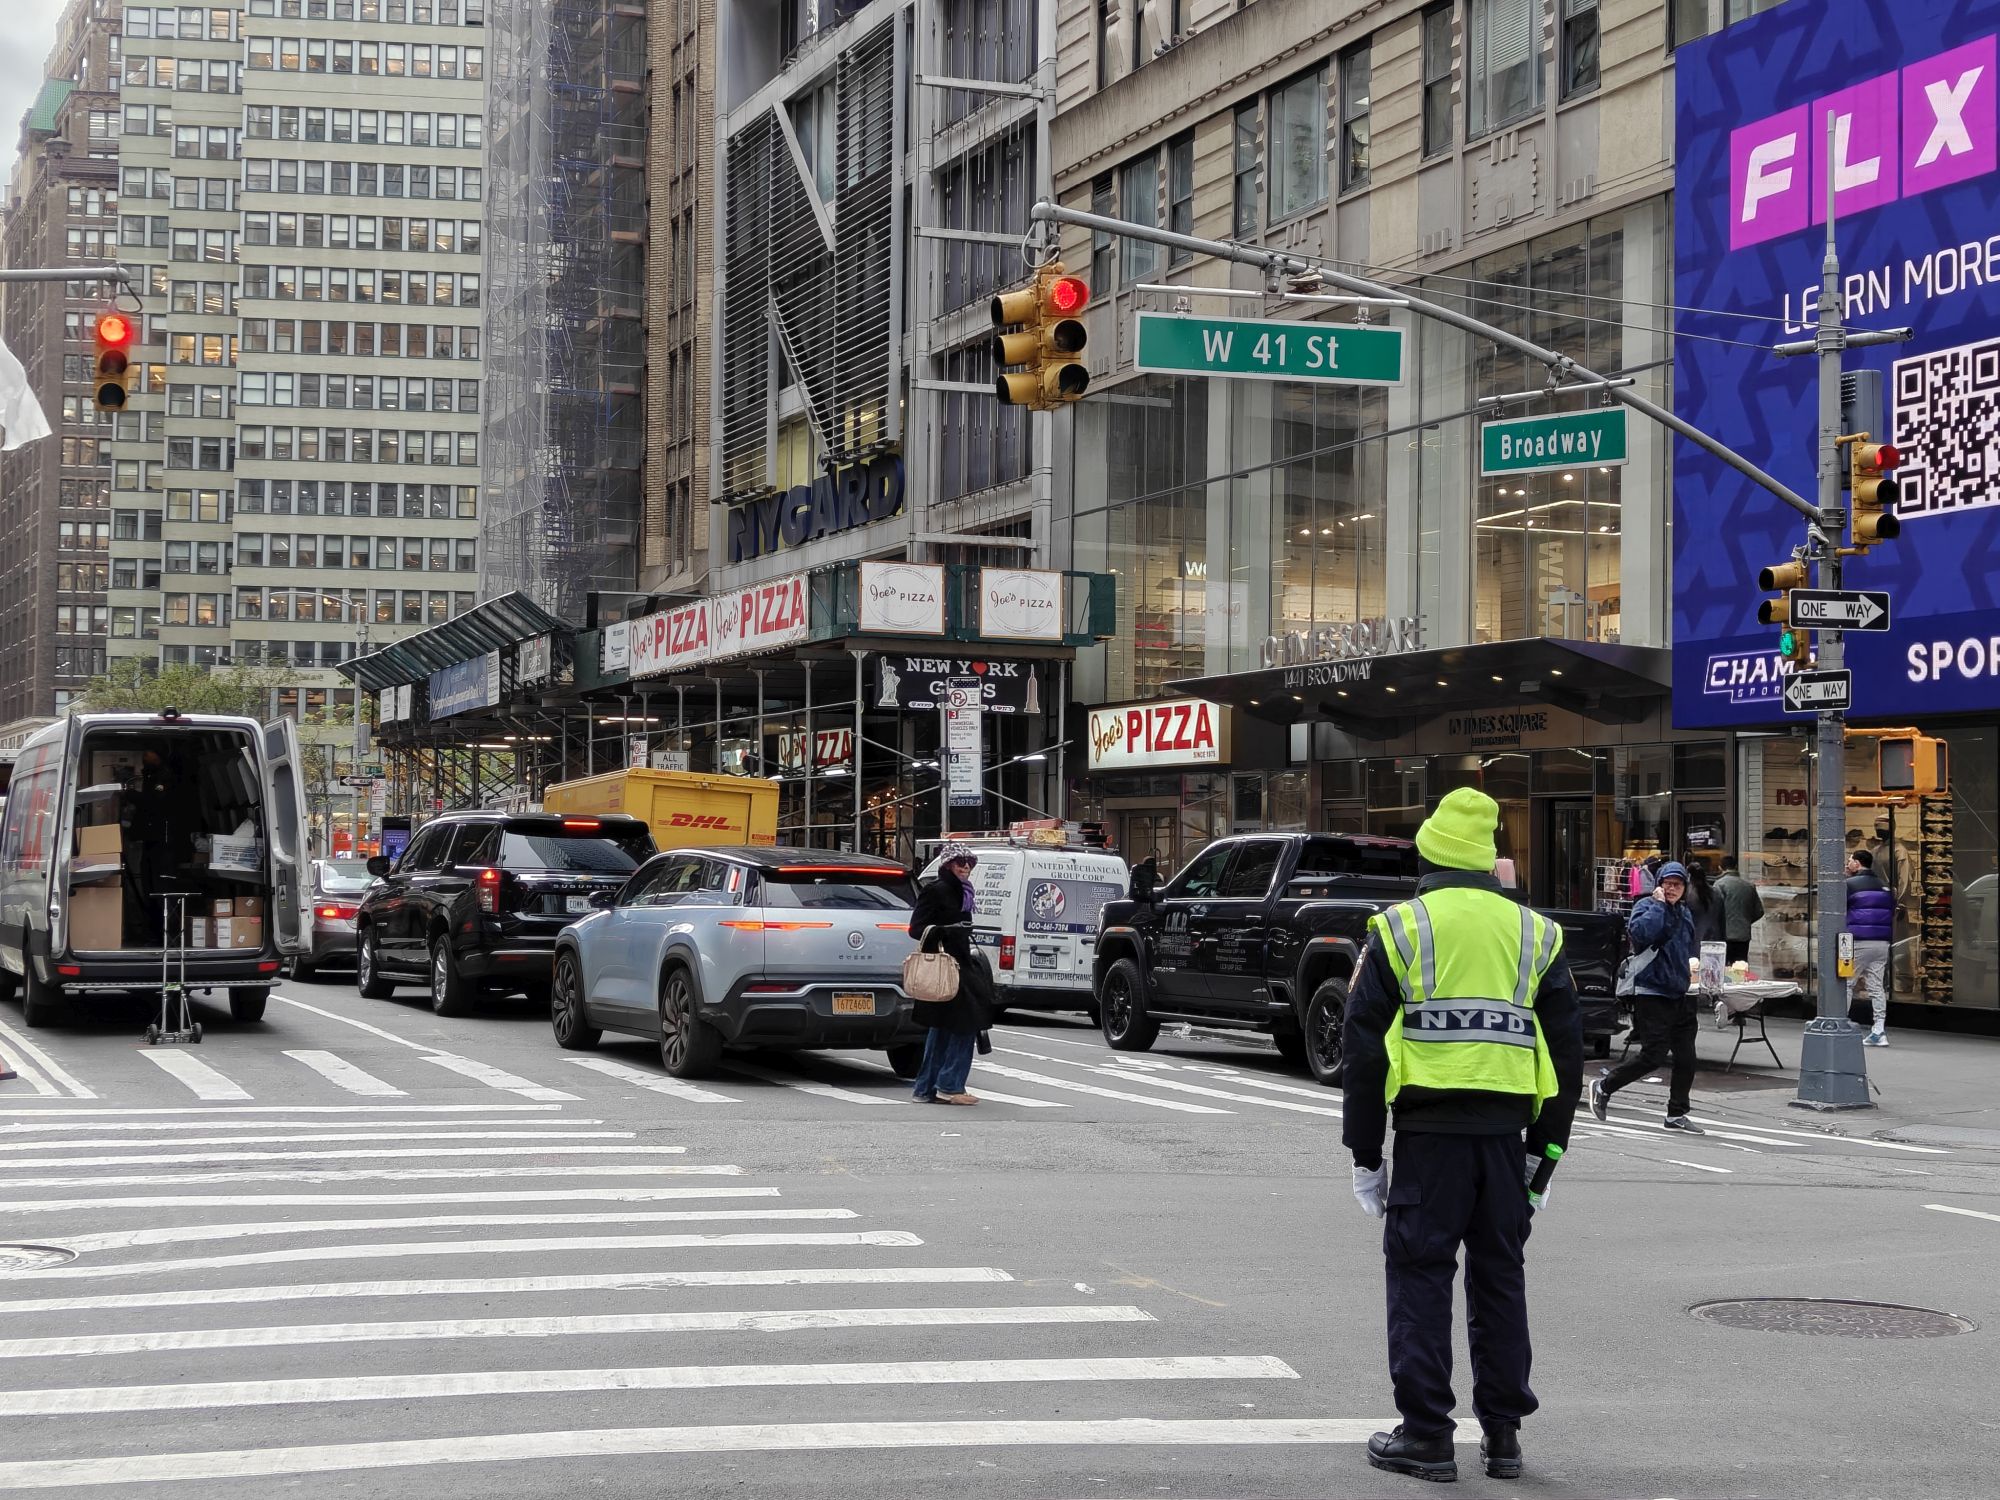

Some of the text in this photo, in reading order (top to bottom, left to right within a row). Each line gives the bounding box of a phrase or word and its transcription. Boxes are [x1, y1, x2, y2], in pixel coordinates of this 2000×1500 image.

[1741, 65, 1985, 224] FLX
[1783, 265, 1892, 335] LERN
[1202, 329, 1340, 369] W 41 St
[1501, 429, 1602, 461] Broadway
[869, 583, 935, 604] Joe's PIZZA
[990, 590, 1054, 609] Joe's PIZZA
[714, 578, 806, 651] Joe's PIZZA
[1801, 602, 1873, 619] ONE WAY
[632, 624, 653, 671] Joe's
[653, 605, 709, 660] PIZZA
[1339, 614, 1428, 658] SQUARE
[905, 657, 951, 674] NEW
[1284, 660, 1374, 689] 1441 BROADWAY
[1709, 652, 1817, 688] CHAM
[1737, 685, 1781, 699] SPOR
[1792, 682, 1845, 700] ONE WAY
[951, 710, 958, 719] 3
[1090, 702, 1215, 763] Joe's PIZZA
[656, 763, 685, 771] TRAFFIC
[662, 753, 678, 762] ALL
[951, 754, 958, 763] 6
[670, 812, 732, 831] DHL
[1031, 862, 1122, 875] UNITED MECHANICAL
[1051, 871, 1105, 882] GROUP CORP
[1420, 1010, 1526, 1034] NYPD
